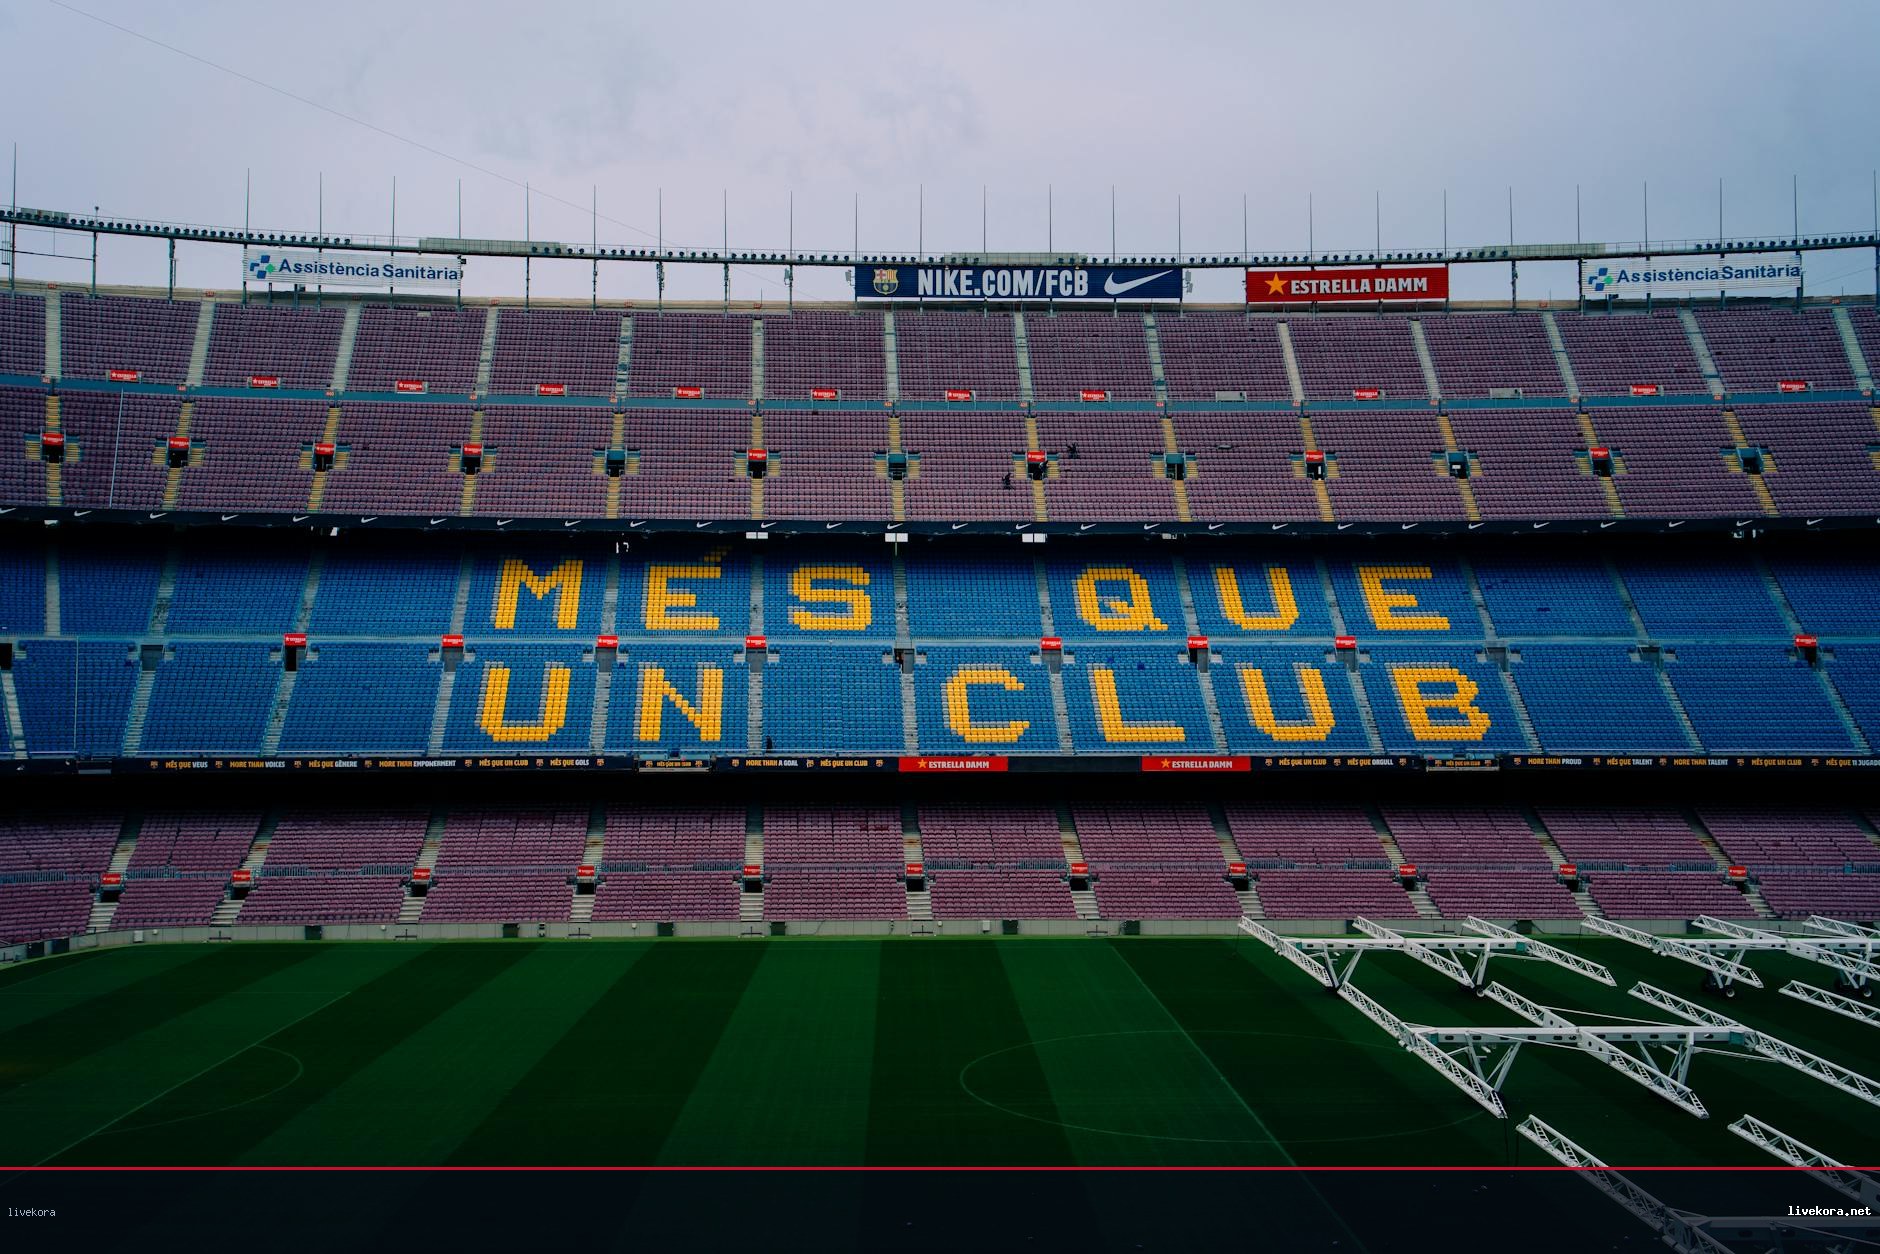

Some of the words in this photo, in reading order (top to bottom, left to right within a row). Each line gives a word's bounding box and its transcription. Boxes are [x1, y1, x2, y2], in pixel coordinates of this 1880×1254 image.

[279, 258, 379, 277] Assistència
[383, 264, 458, 280] Sanitària
[1617, 267, 1719, 284] Assistència
[1722, 264, 1801, 279] Sanitària
[918, 269, 1089, 296] NIKE.COM/FCB
[1291, 278, 1371, 295] ESTRELLA
[1374, 277, 1428, 293] DAMM
[1076, 567, 1452, 631] QUE
[480, 667, 724, 742] UN
[946, 667, 1492, 743] CLUB
[929, 761, 964, 769] ESTRELLA
[966, 761, 989, 769] DAMM
